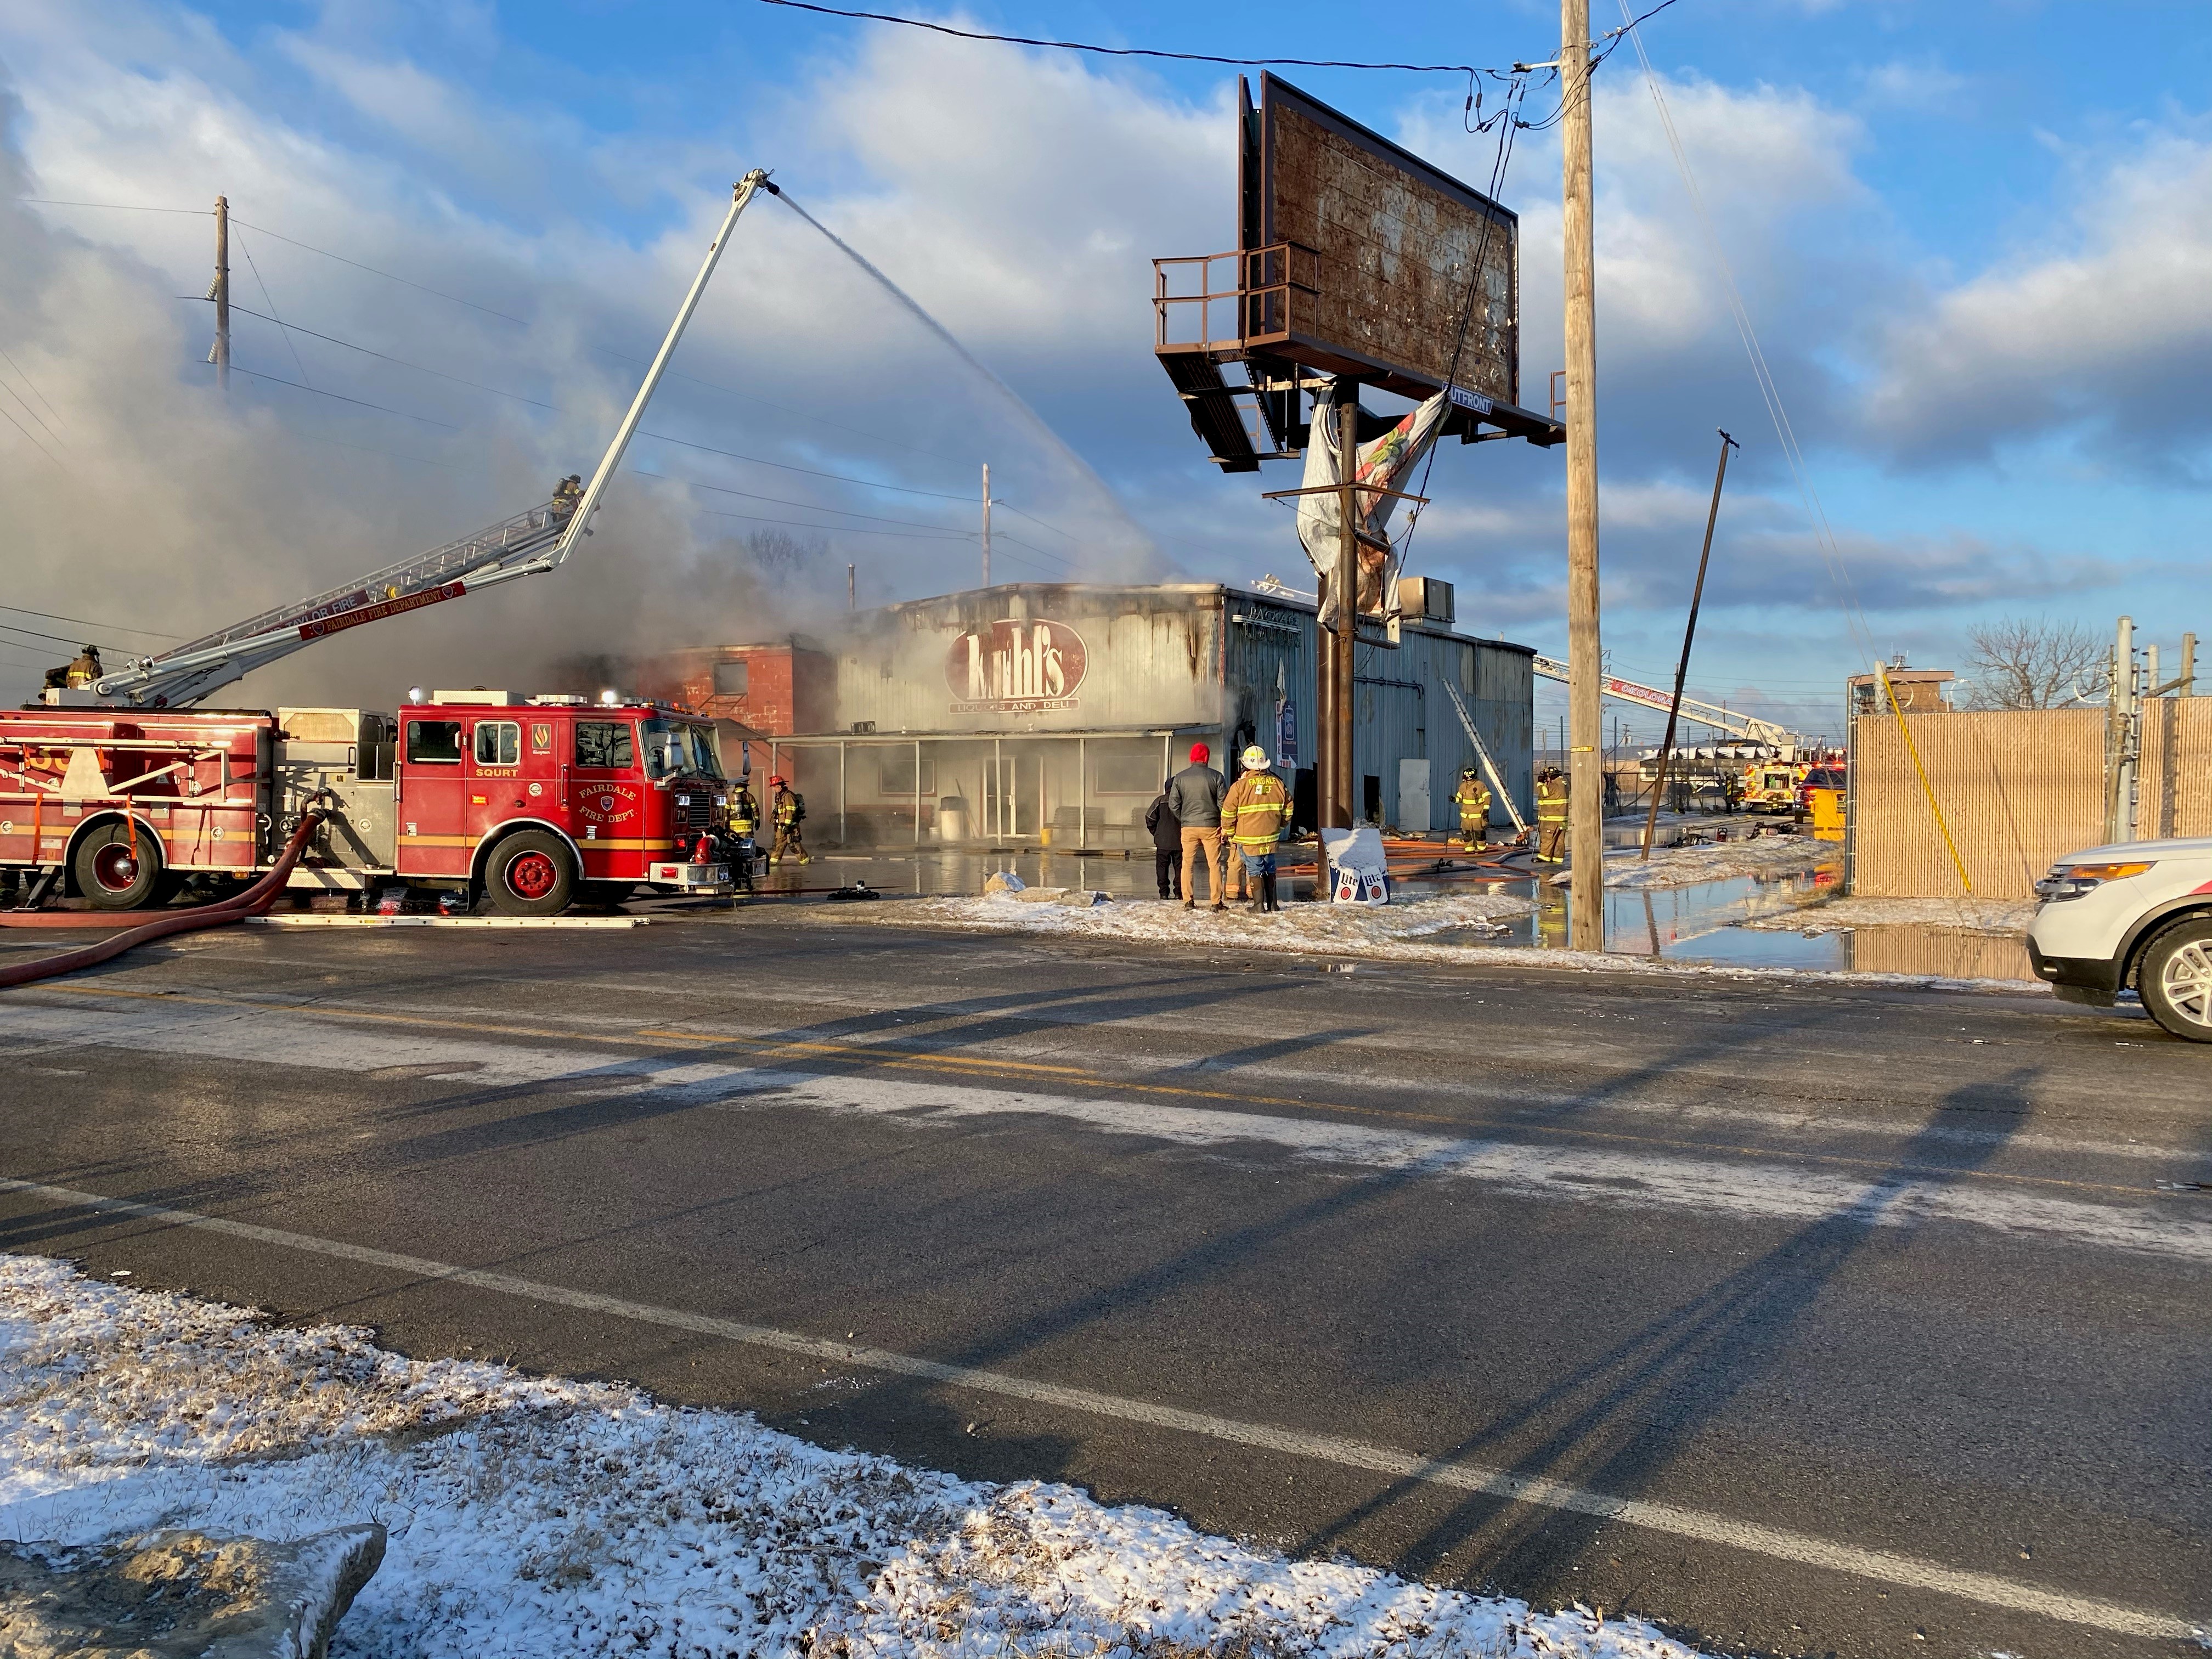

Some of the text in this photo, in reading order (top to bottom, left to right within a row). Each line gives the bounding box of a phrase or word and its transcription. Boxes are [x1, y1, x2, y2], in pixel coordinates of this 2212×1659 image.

[325, 590, 442, 631] FAIRDALE FIRE DEPARTMENT
[332, 595, 357, 614] FIRE
[1621, 684, 1673, 707] OKOLONA
[1012, 702, 1036, 711] AND
[1043, 700, 1069, 709] DELI
[476, 769, 518, 777] SQURT
[1248, 777, 1277, 786] FAIRDALE
[579, 784, 636, 801] FAIRDALE
[579, 805, 604, 822] FIRE
[1340, 873, 1381, 887] Lite Lite
